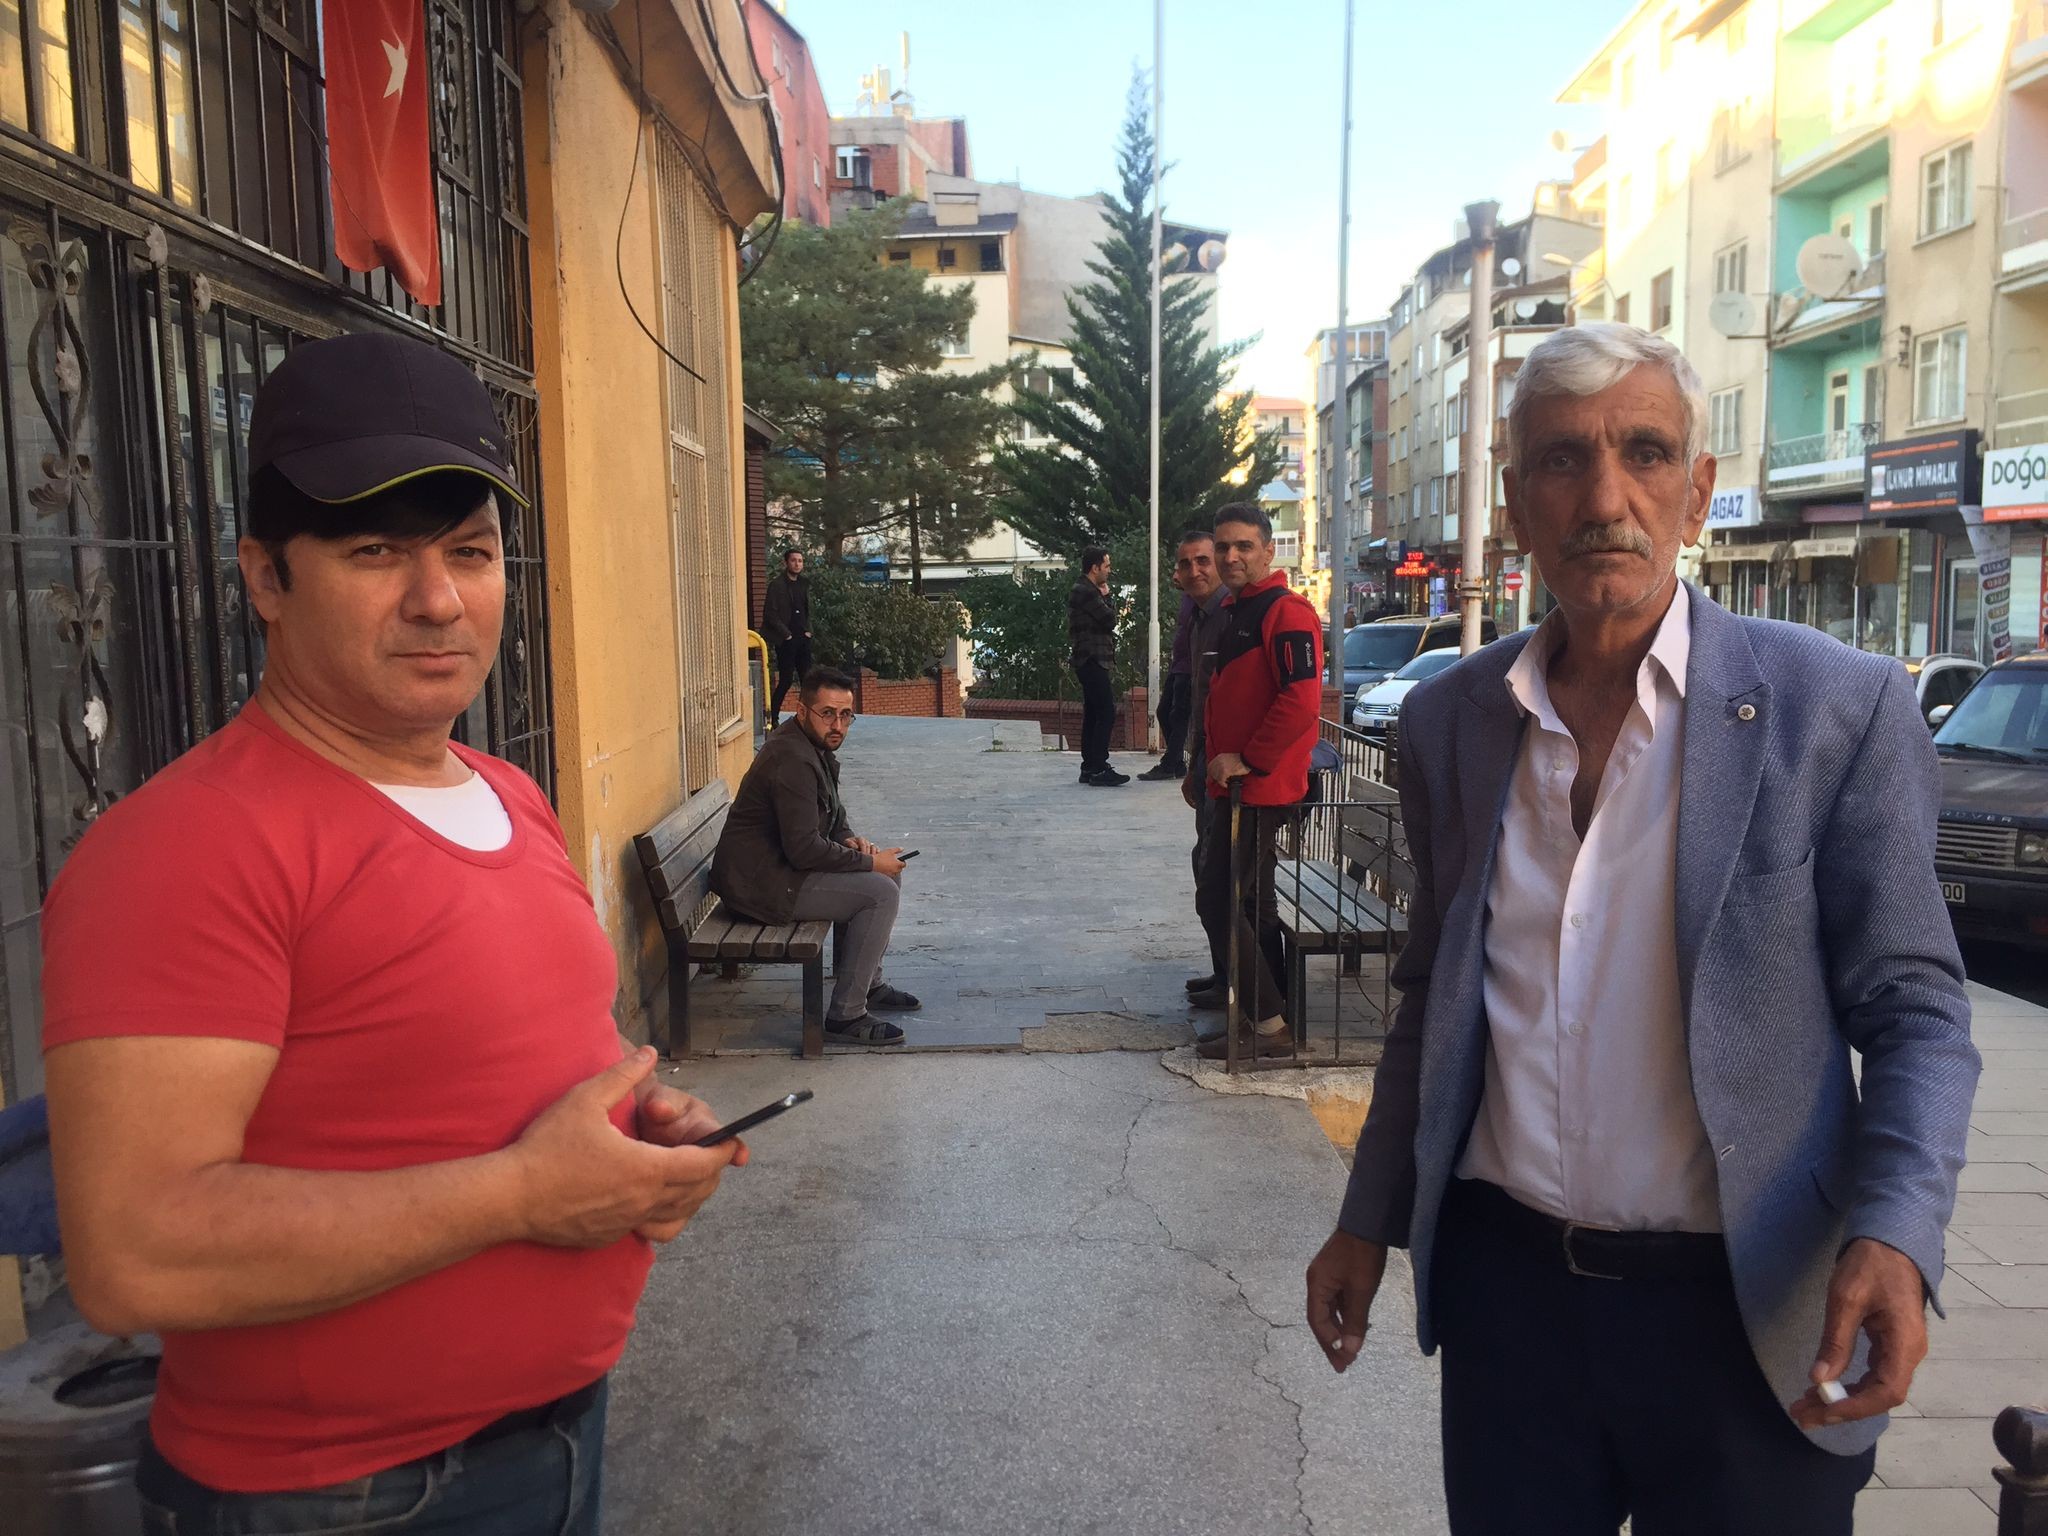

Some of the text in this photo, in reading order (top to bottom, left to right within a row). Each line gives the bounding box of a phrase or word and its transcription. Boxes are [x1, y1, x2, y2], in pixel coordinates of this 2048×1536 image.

[1915, 460, 1958, 487] MİMARLIK
[1707, 494, 1744, 521] AGAZ
[1938, 884, 1963, 901] 00
